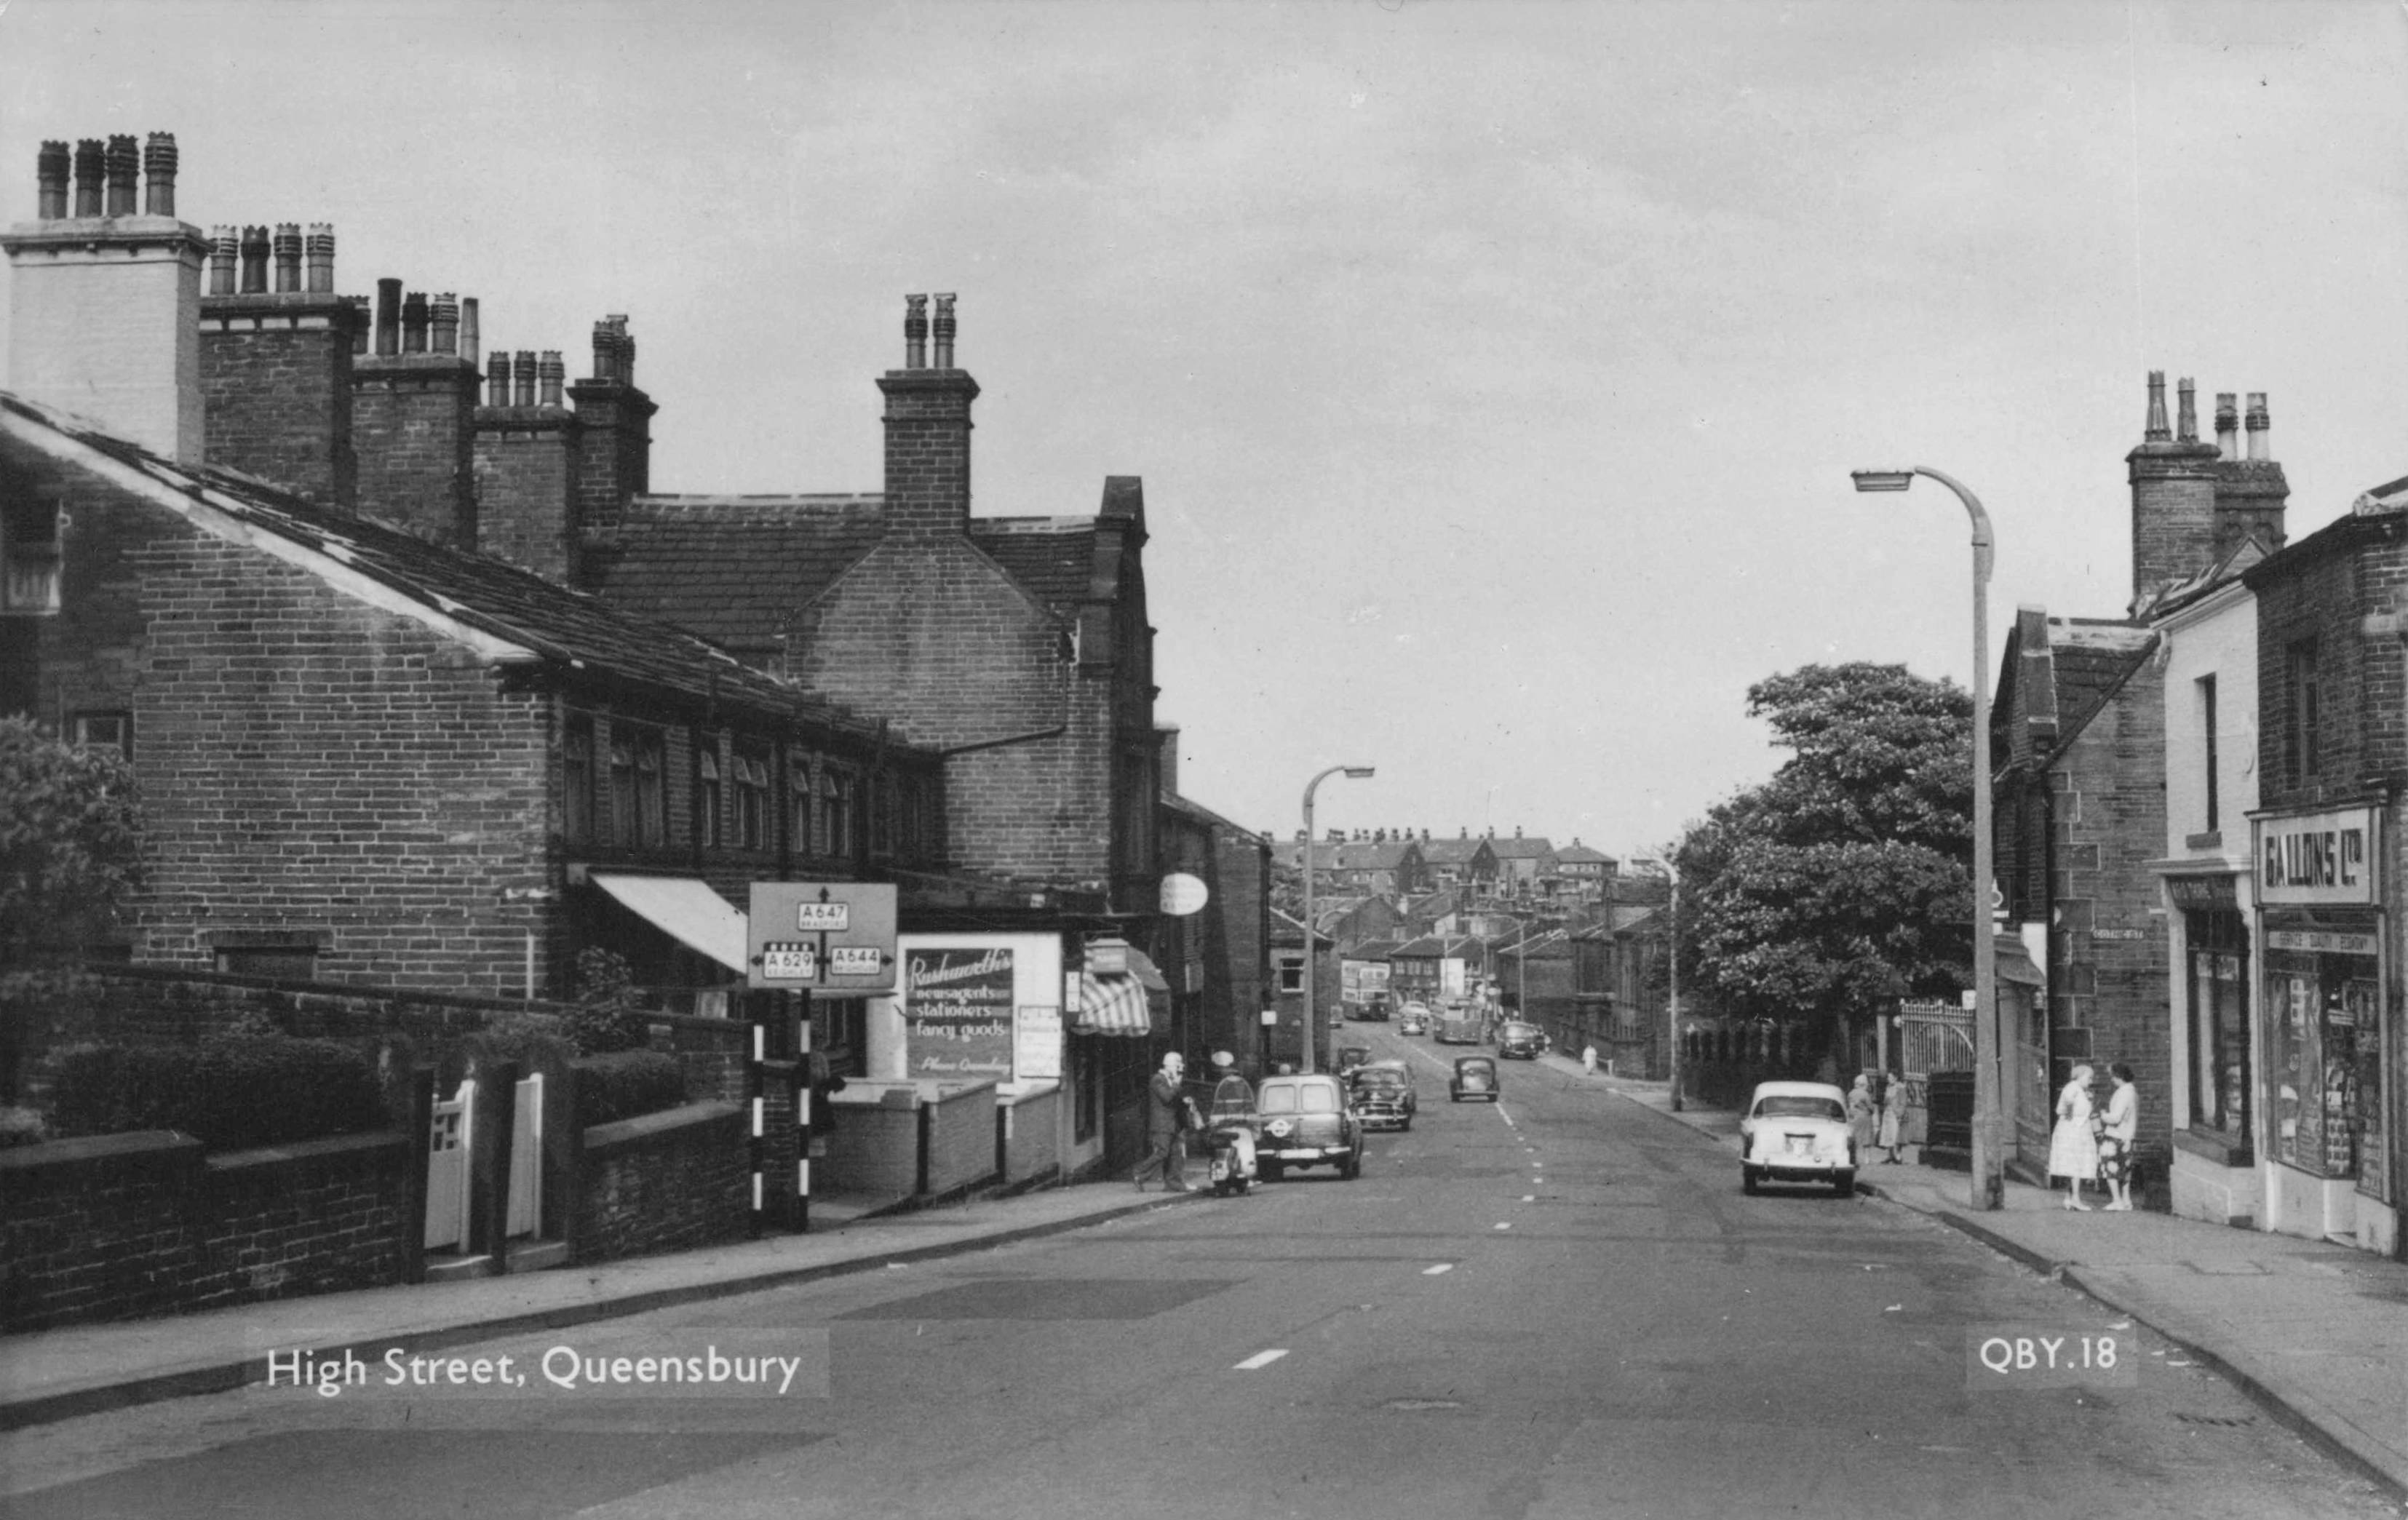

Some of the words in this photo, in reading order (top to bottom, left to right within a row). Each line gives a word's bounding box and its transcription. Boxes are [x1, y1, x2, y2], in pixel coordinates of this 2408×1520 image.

[2266, 831, 2336, 888] GALLONS
[916, 984, 996, 1005] newsagents
[916, 1001, 993, 1017] stationers
[916, 1019, 955, 1040] fancy
[961, 1019, 1006, 1042] goods
